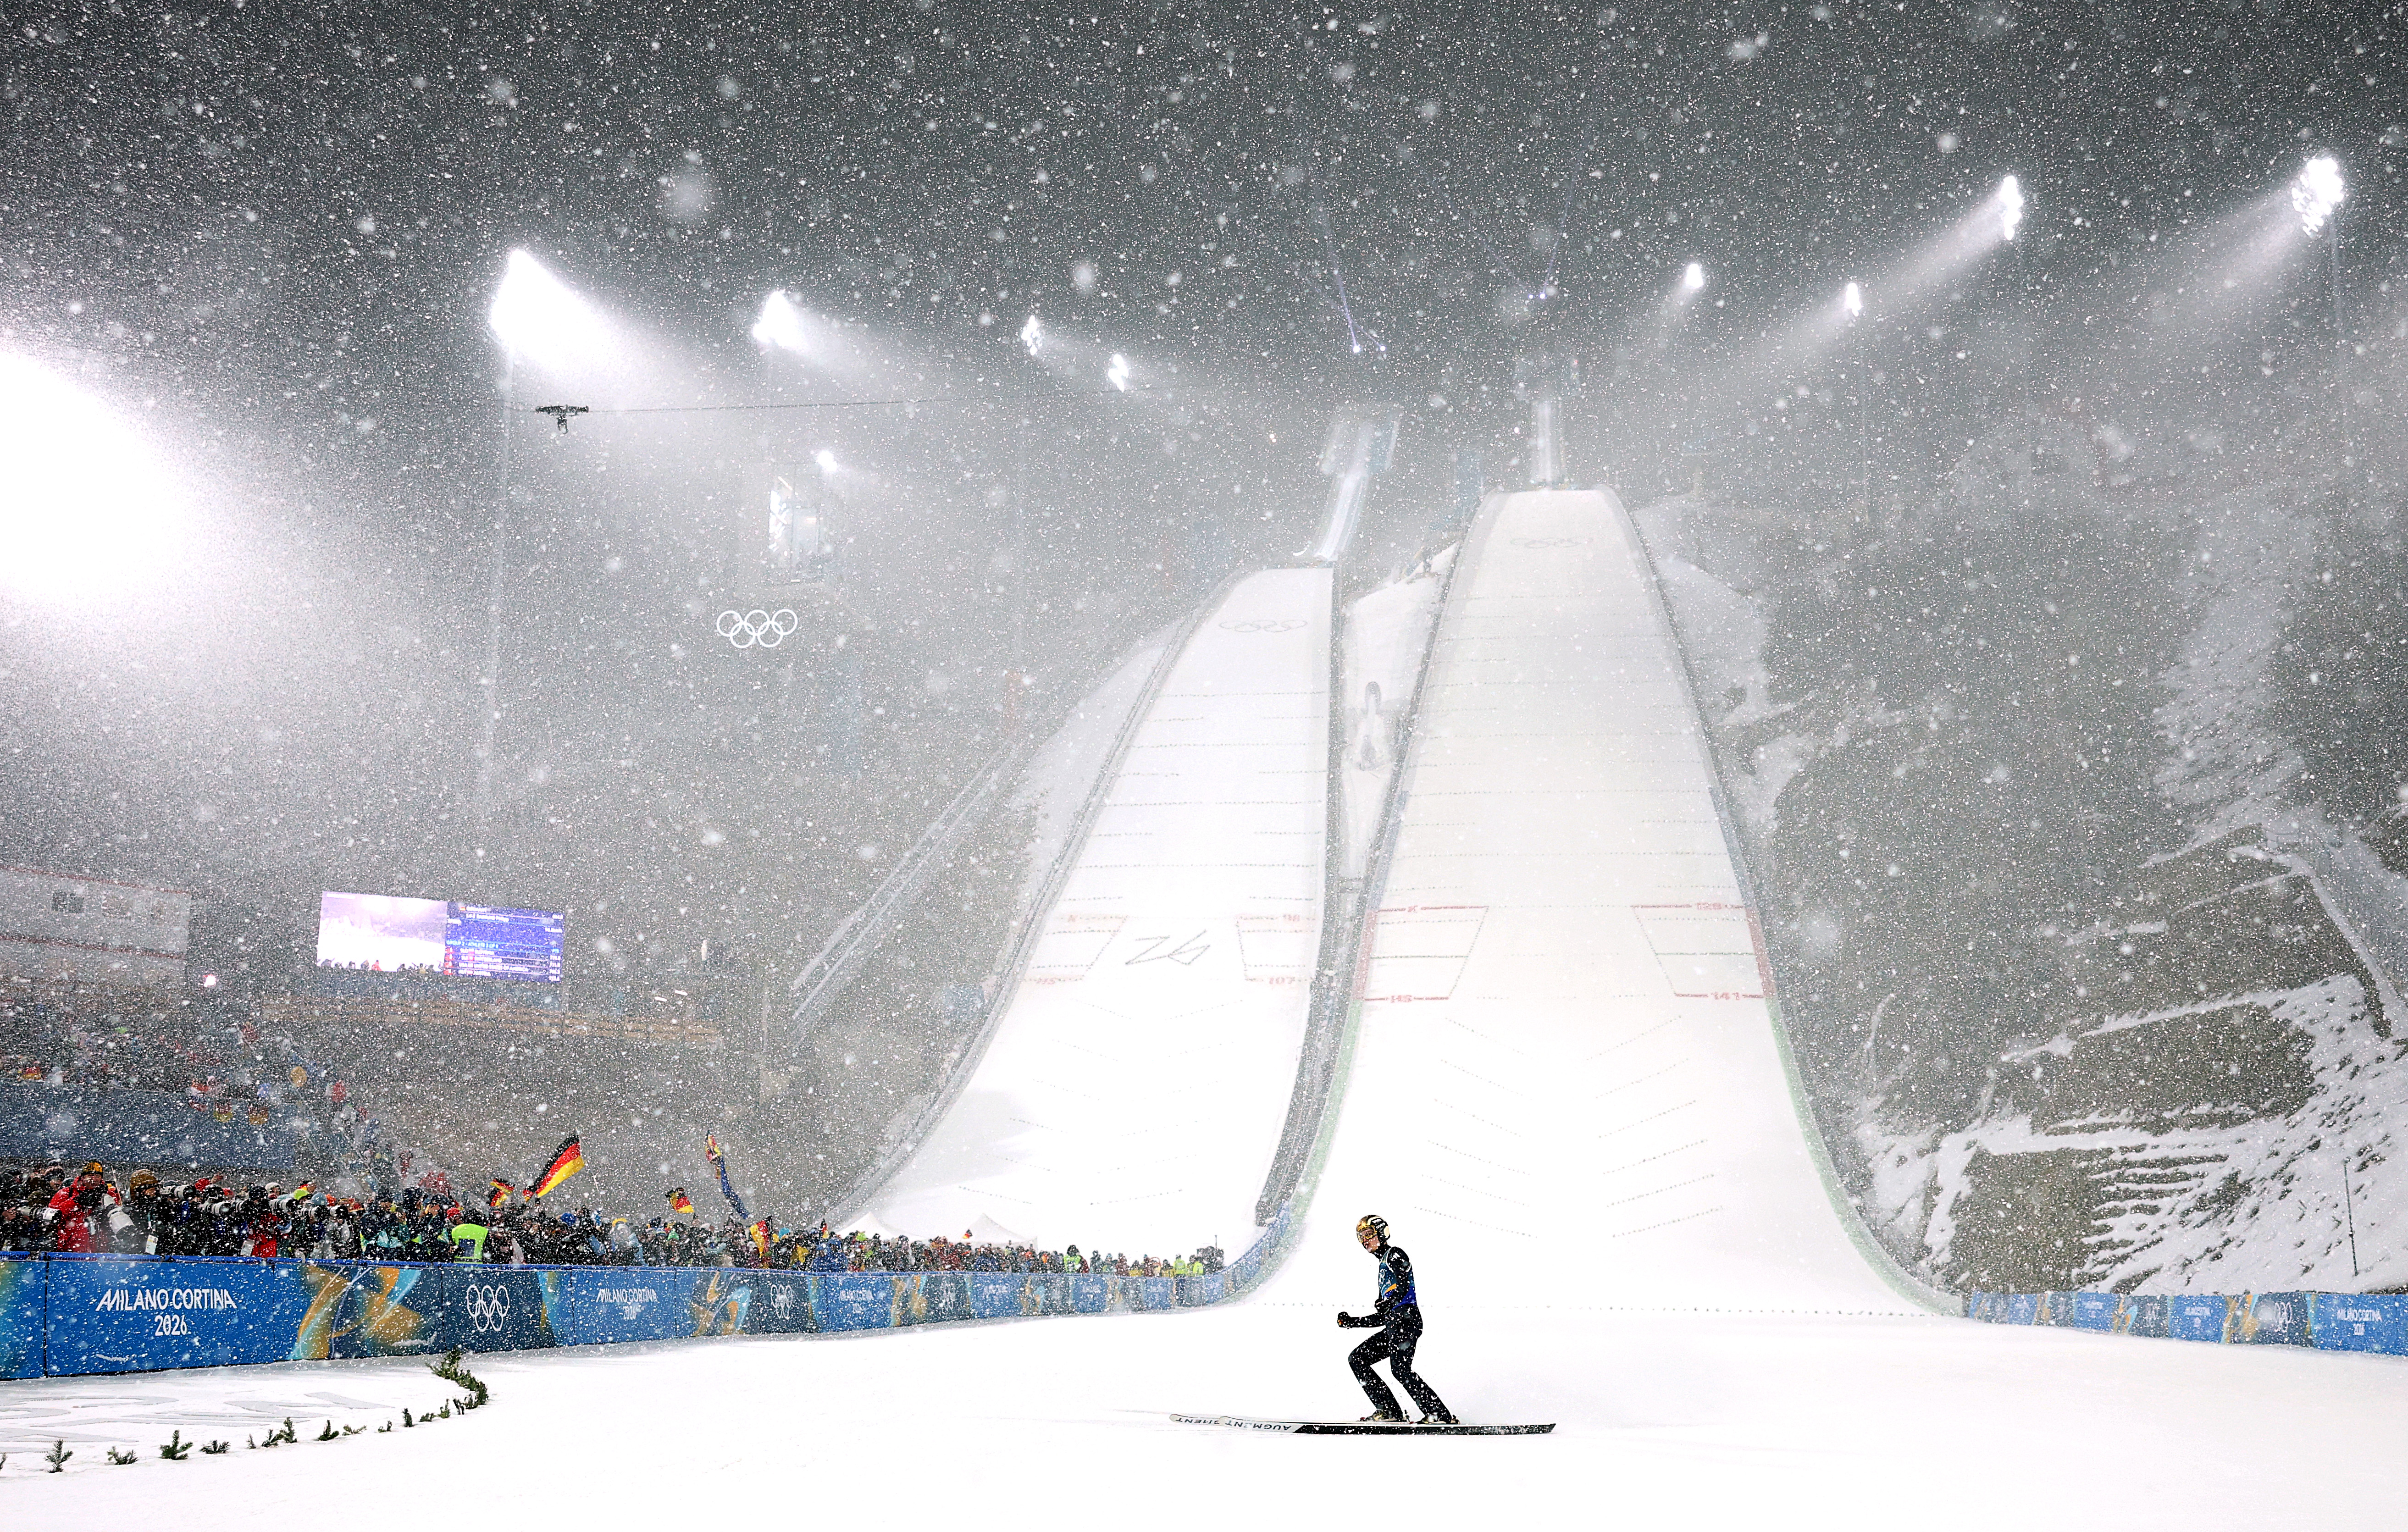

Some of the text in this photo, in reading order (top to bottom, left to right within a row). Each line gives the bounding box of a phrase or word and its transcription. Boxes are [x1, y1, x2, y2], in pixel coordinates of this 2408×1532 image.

[95, 1288, 238, 1311] MILANO CORTINA
[596, 1288, 659, 1303] MILANO CORTINA
[155, 1314, 188, 1336] 2026
